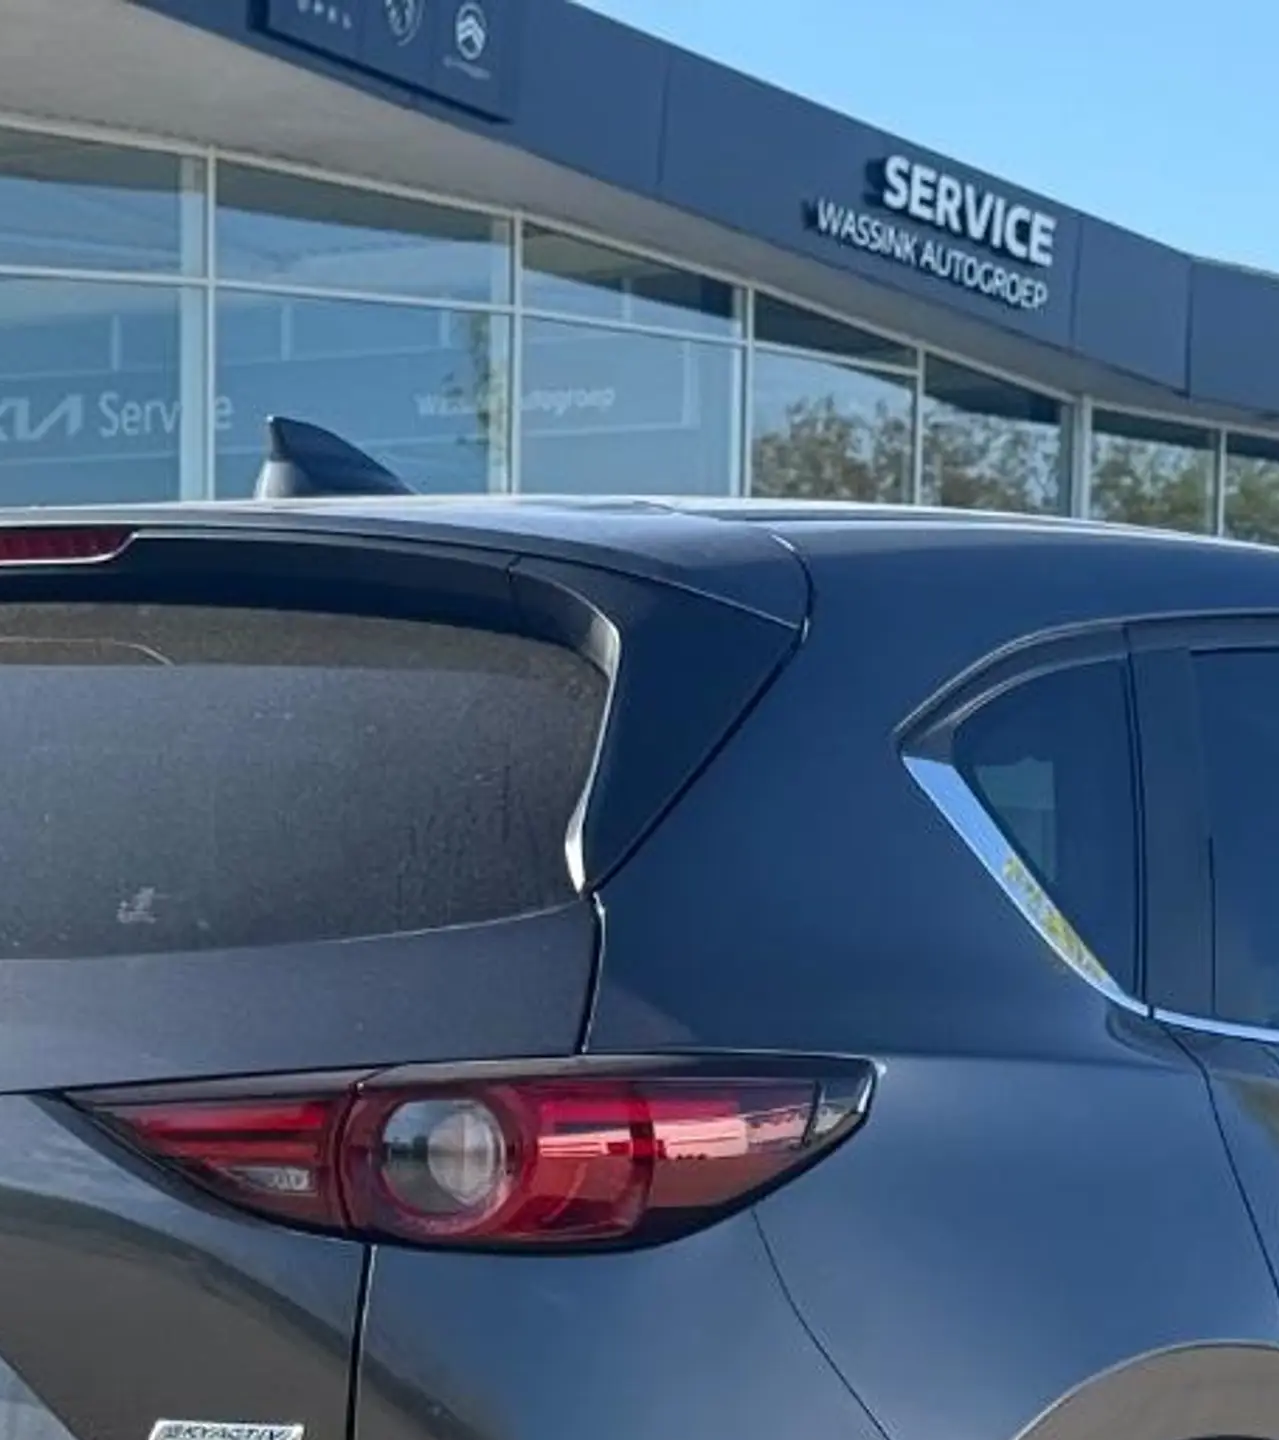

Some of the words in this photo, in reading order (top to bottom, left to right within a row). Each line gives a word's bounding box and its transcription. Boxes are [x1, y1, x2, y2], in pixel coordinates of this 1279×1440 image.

[817, 198, 918, 266] WASSINK
[919, 239, 1049, 310] AUTOGROEP
[882, 154, 1057, 268] SERVICE
[98, 390, 235, 438] Serve
